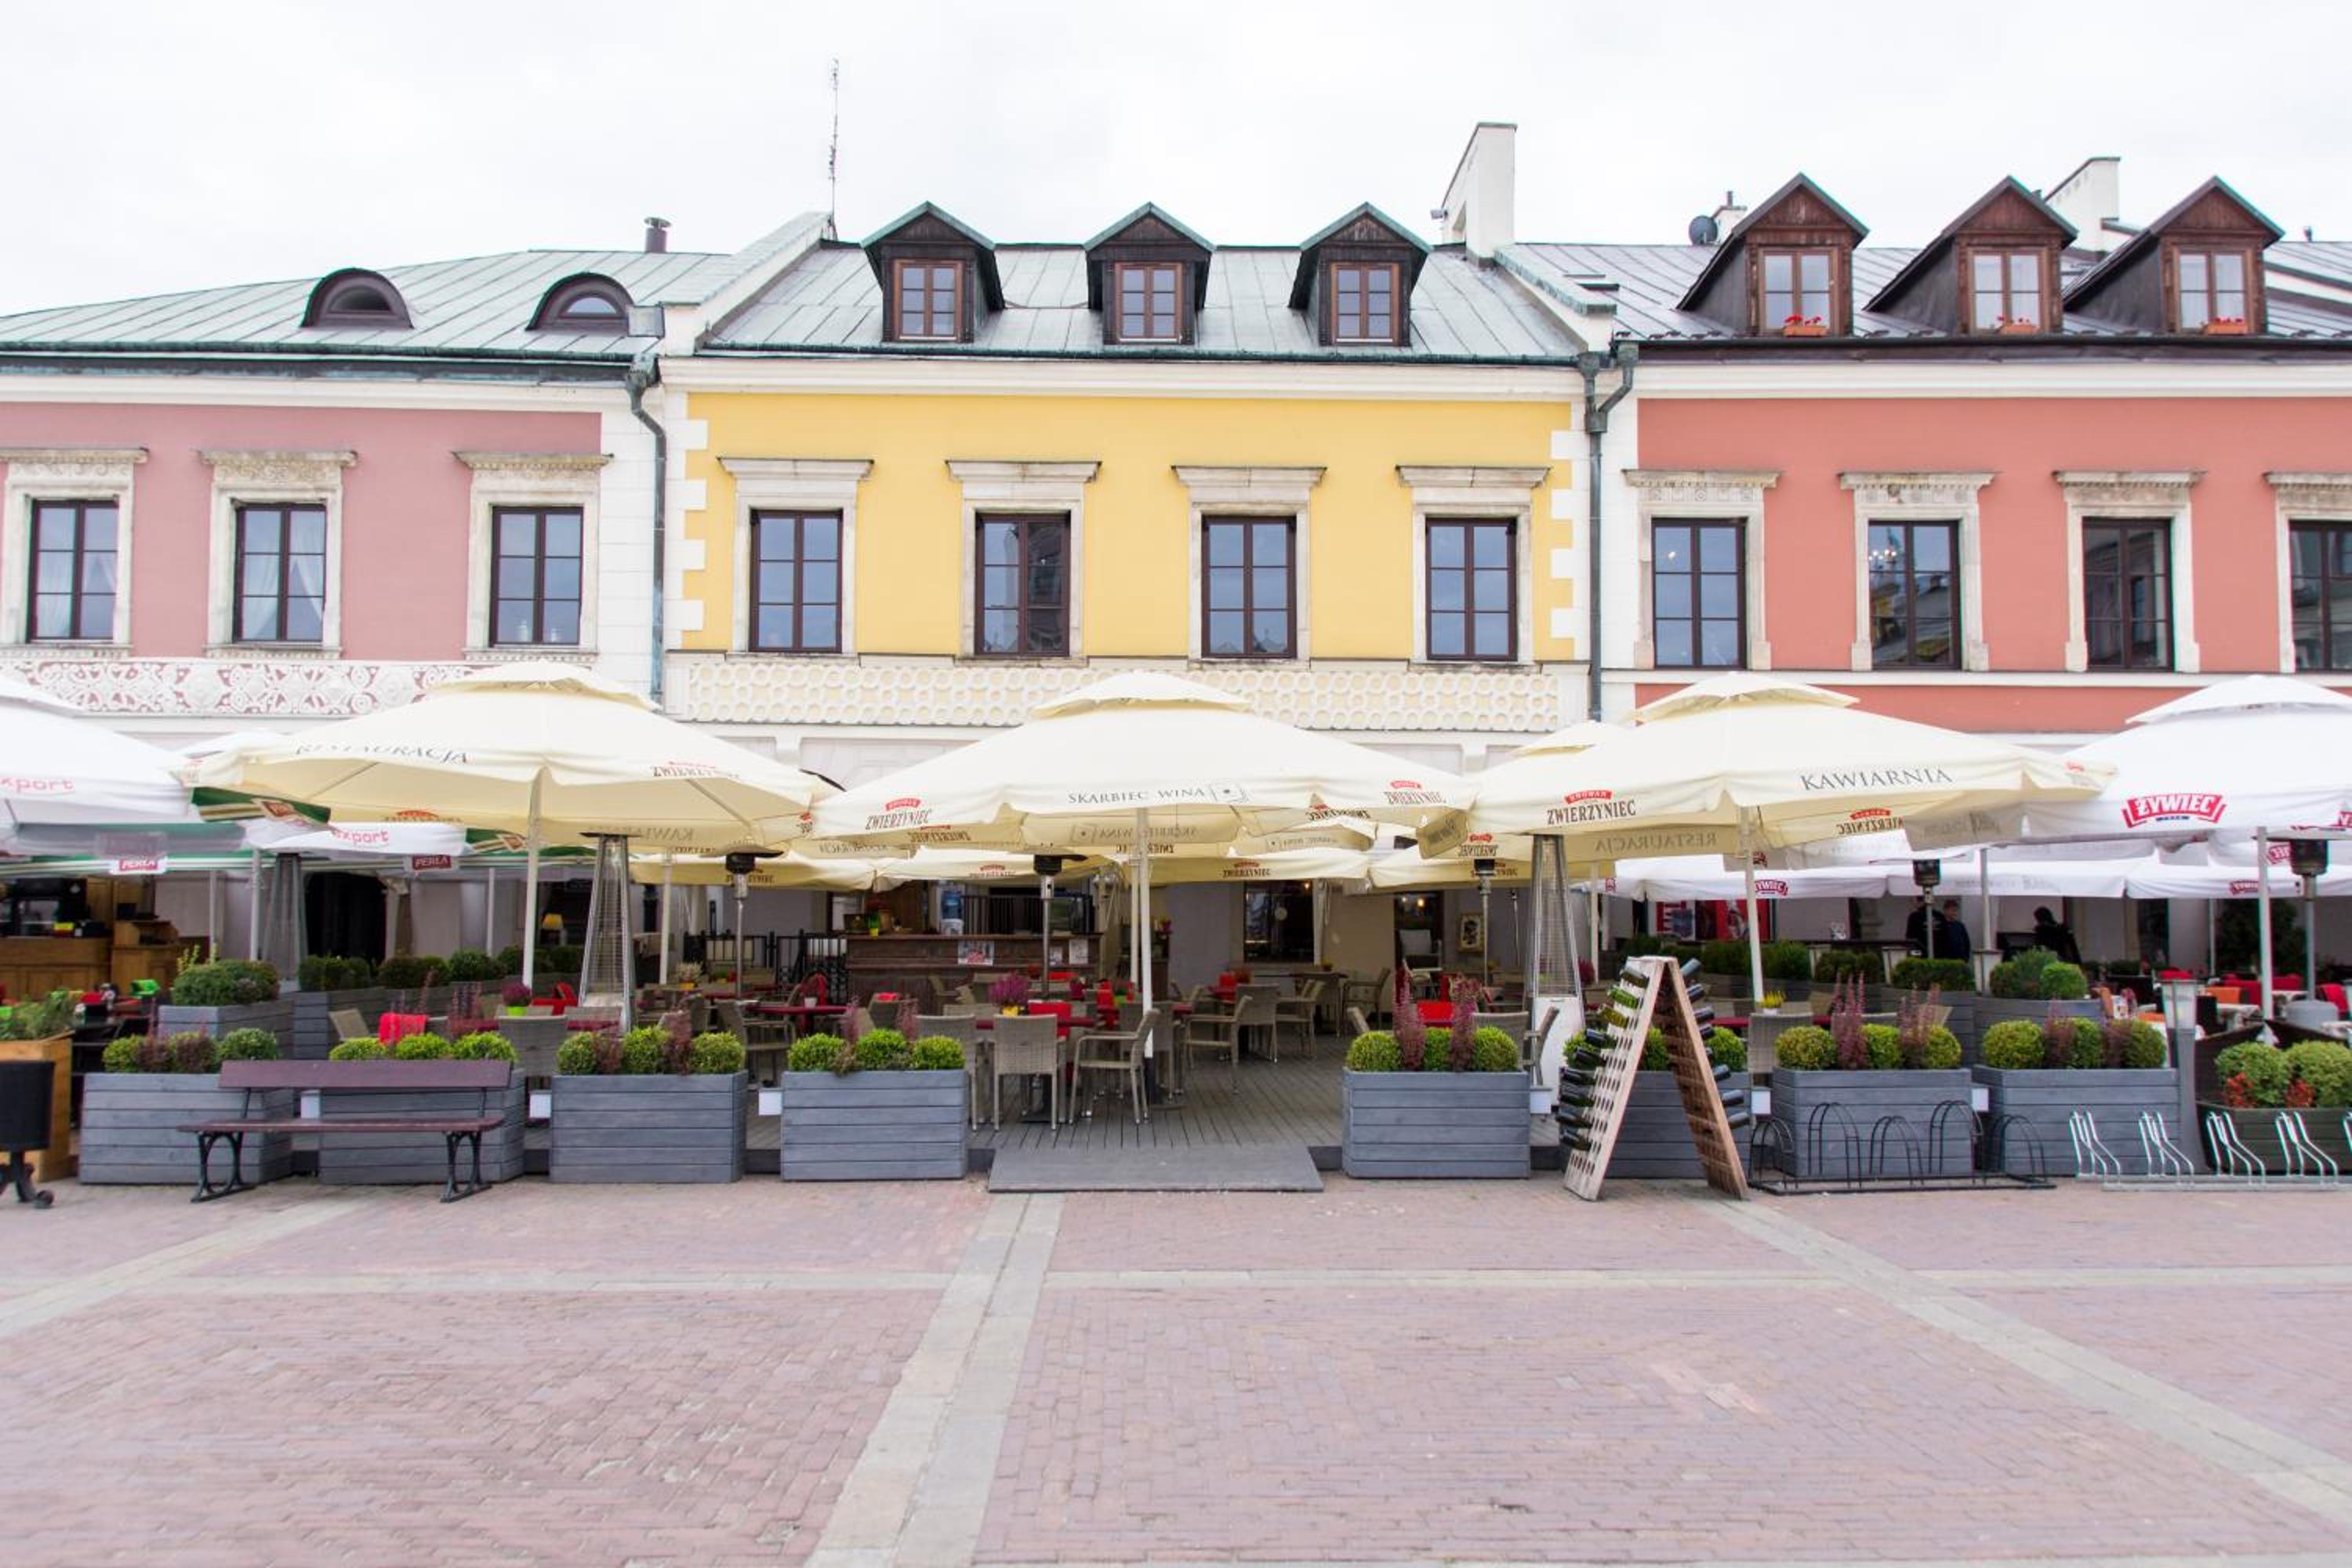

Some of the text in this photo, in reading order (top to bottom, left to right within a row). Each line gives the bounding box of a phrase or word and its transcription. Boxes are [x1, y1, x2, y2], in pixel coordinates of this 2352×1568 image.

[1800, 767, 1953, 790] KAWIARNIA
[1068, 788, 1205, 804] SKARBIEC WINA
[865, 808, 931, 830] ZWIERZYNIEC
[1547, 800, 1636, 825] ZWIERZYNIEC
